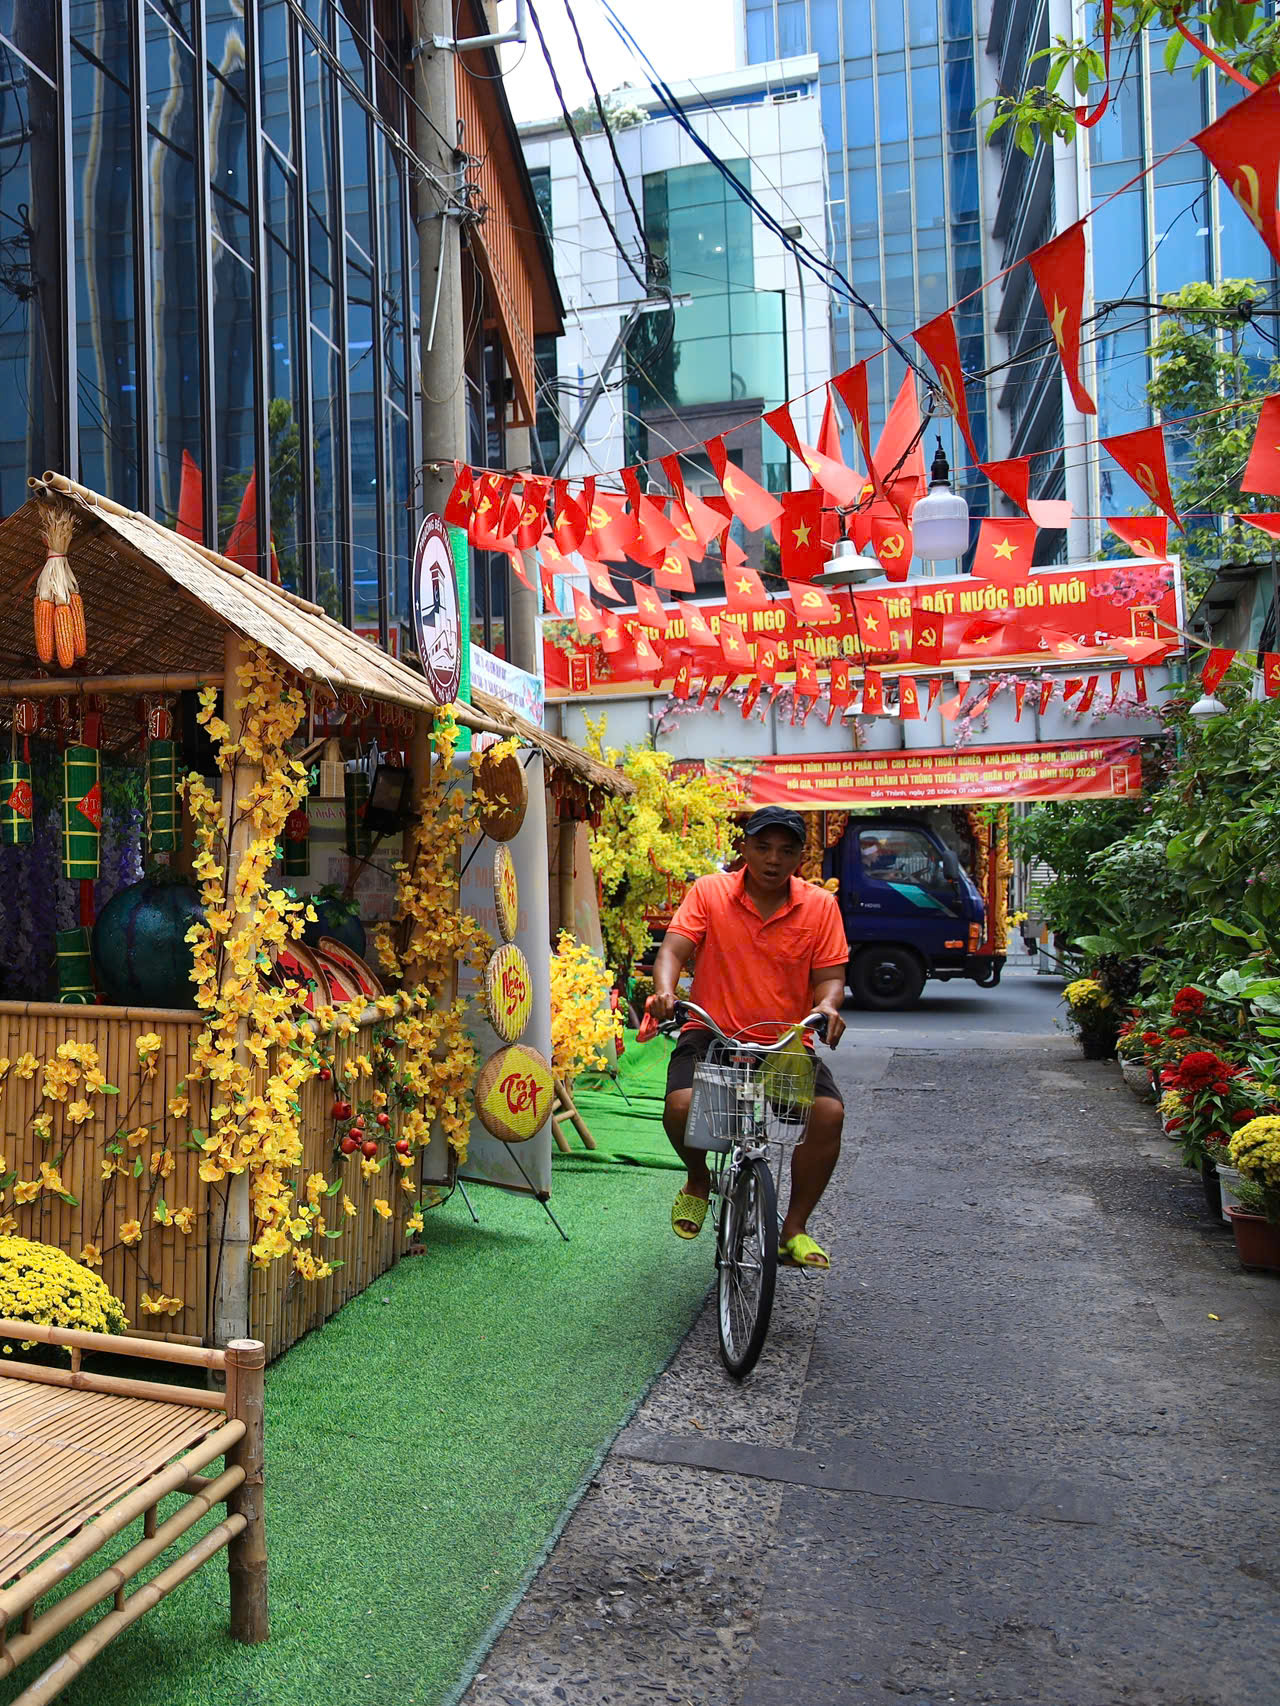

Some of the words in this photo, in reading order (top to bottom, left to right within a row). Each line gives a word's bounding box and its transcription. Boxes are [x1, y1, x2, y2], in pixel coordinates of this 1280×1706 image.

[753, 610, 786, 634] NGỌ
[960, 585, 1009, 613] NƯỚC
[1014, 580, 1043, 608] ĐỔI
[1050, 578, 1086, 604] MỚI
[891, 760, 905, 769] CHO
[907, 757, 921, 768] CÁC
[923, 757, 932, 769] HỘ
[899, 774, 909, 785] VÀ
[1019, 768, 1038, 779] XUÂN
[1060, 768, 1074, 780] NGỌ
[1075, 767, 1097, 778] 2026
[909, 788, 925, 797] ngày
[937, 787, 957, 795] tháng
[500, 1073, 544, 1118] Tết
